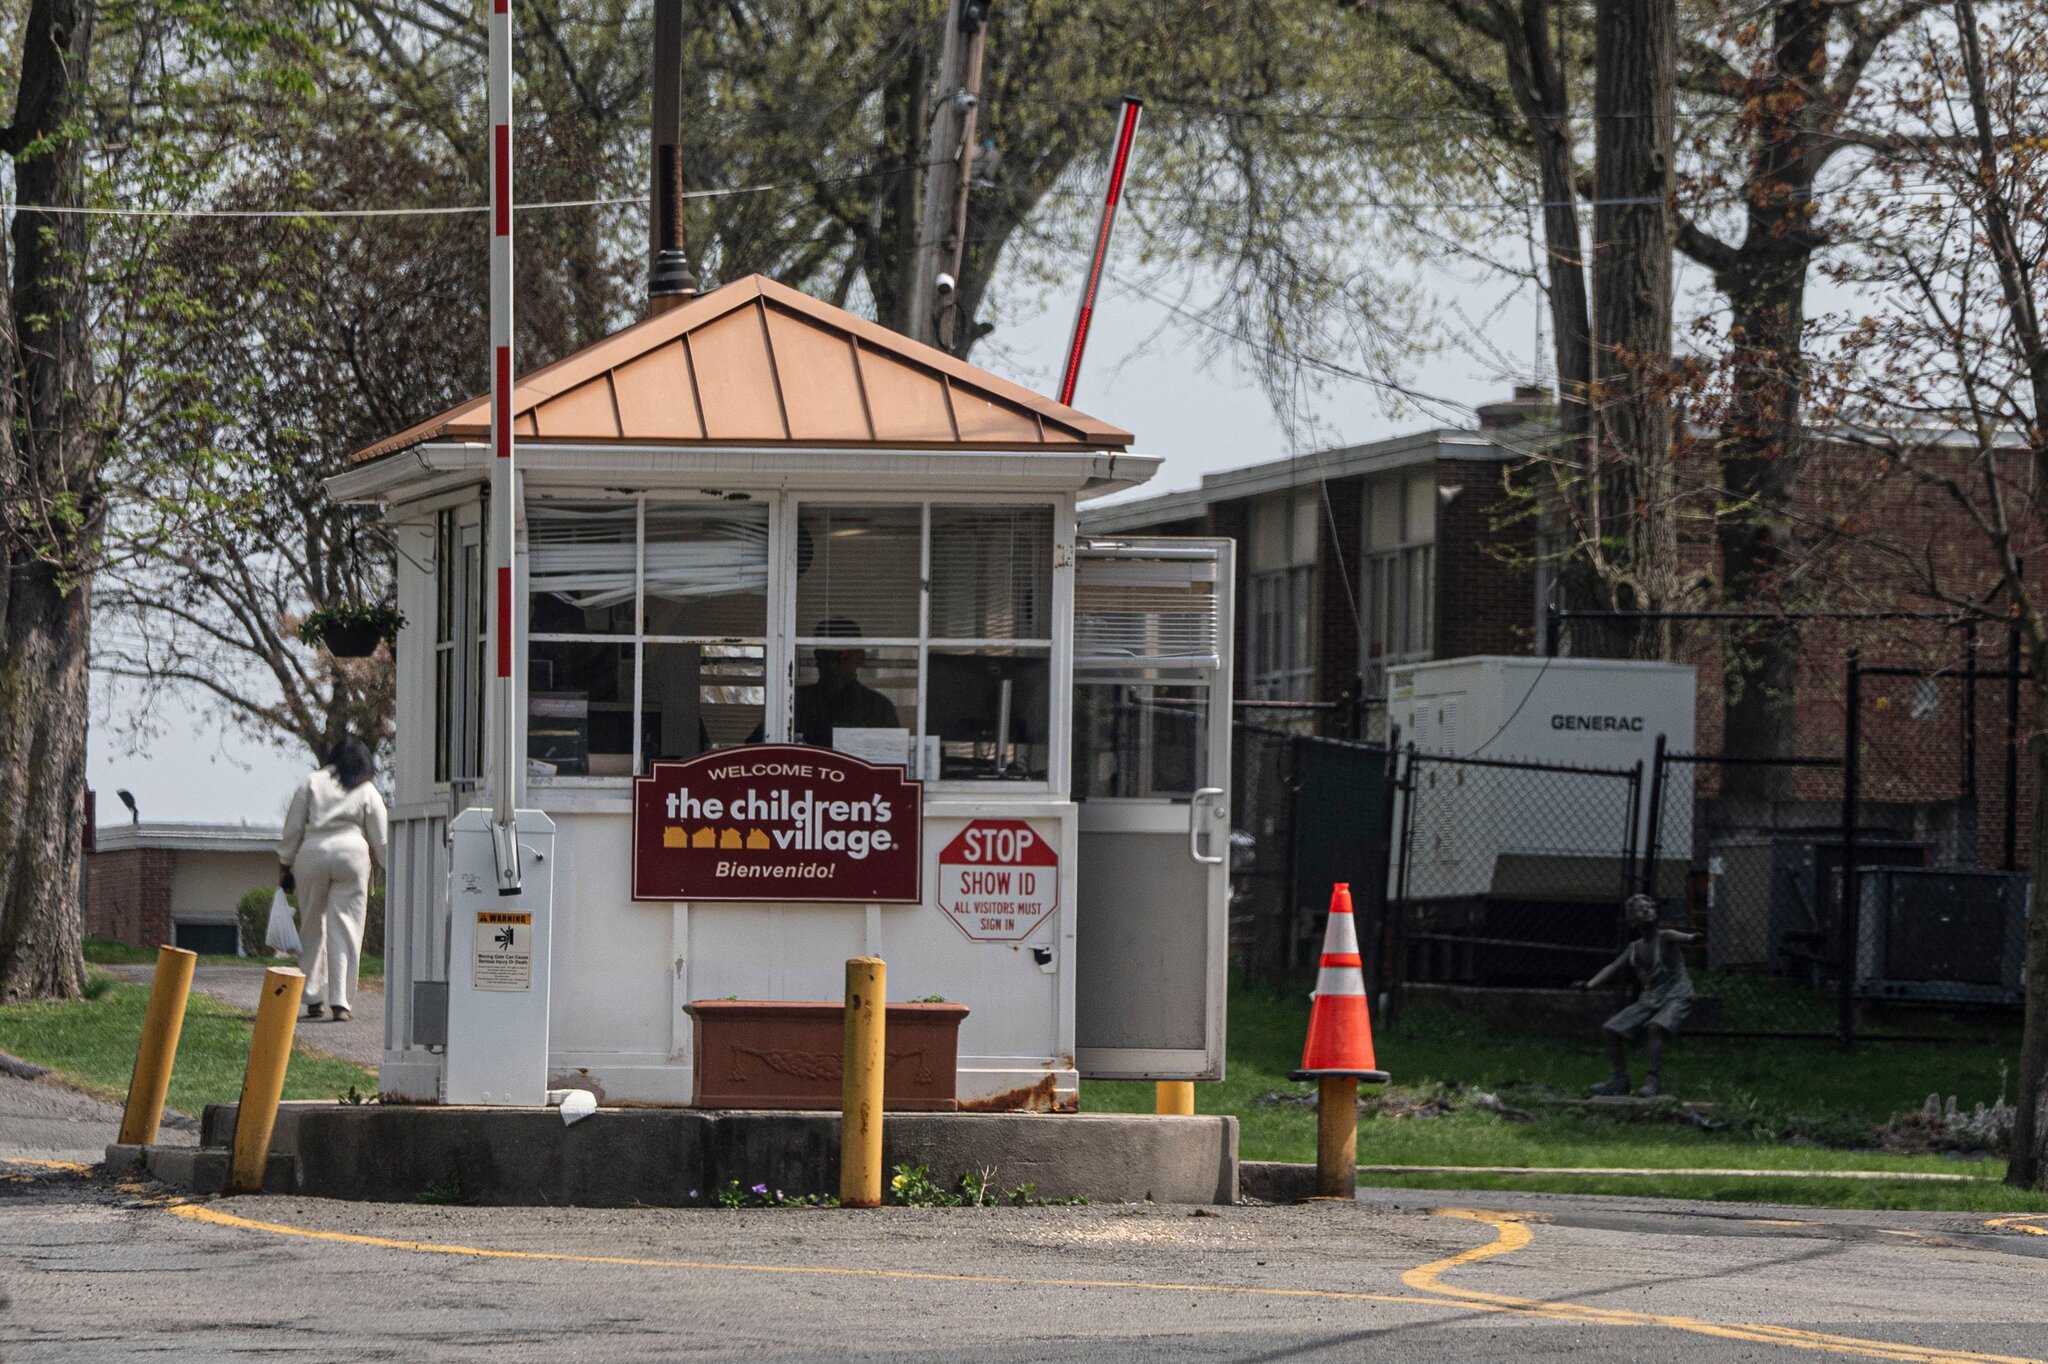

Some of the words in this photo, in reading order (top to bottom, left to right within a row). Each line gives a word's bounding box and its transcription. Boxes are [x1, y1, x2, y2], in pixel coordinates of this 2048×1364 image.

[1551, 714, 1643, 731] GENERAC
[708, 763, 813, 781] WELCOME
[817, 767, 845, 782] TO
[666, 788, 723, 819] the
[730, 789, 892, 822] children's
[963, 828, 1033, 862] STOP
[715, 861, 835, 878] Bienvenido!
[960, 871, 1011, 895] SHOW
[1018, 872, 1036, 895] ID
[954, 901, 970, 914] ALL
[974, 902, 1015, 915] VISITORS
[1018, 902, 1042, 915] MUST
[489, 914, 526, 923] WARNING
[980, 918, 1002, 931] SIGN
[1005, 919, 1014, 931] IN
